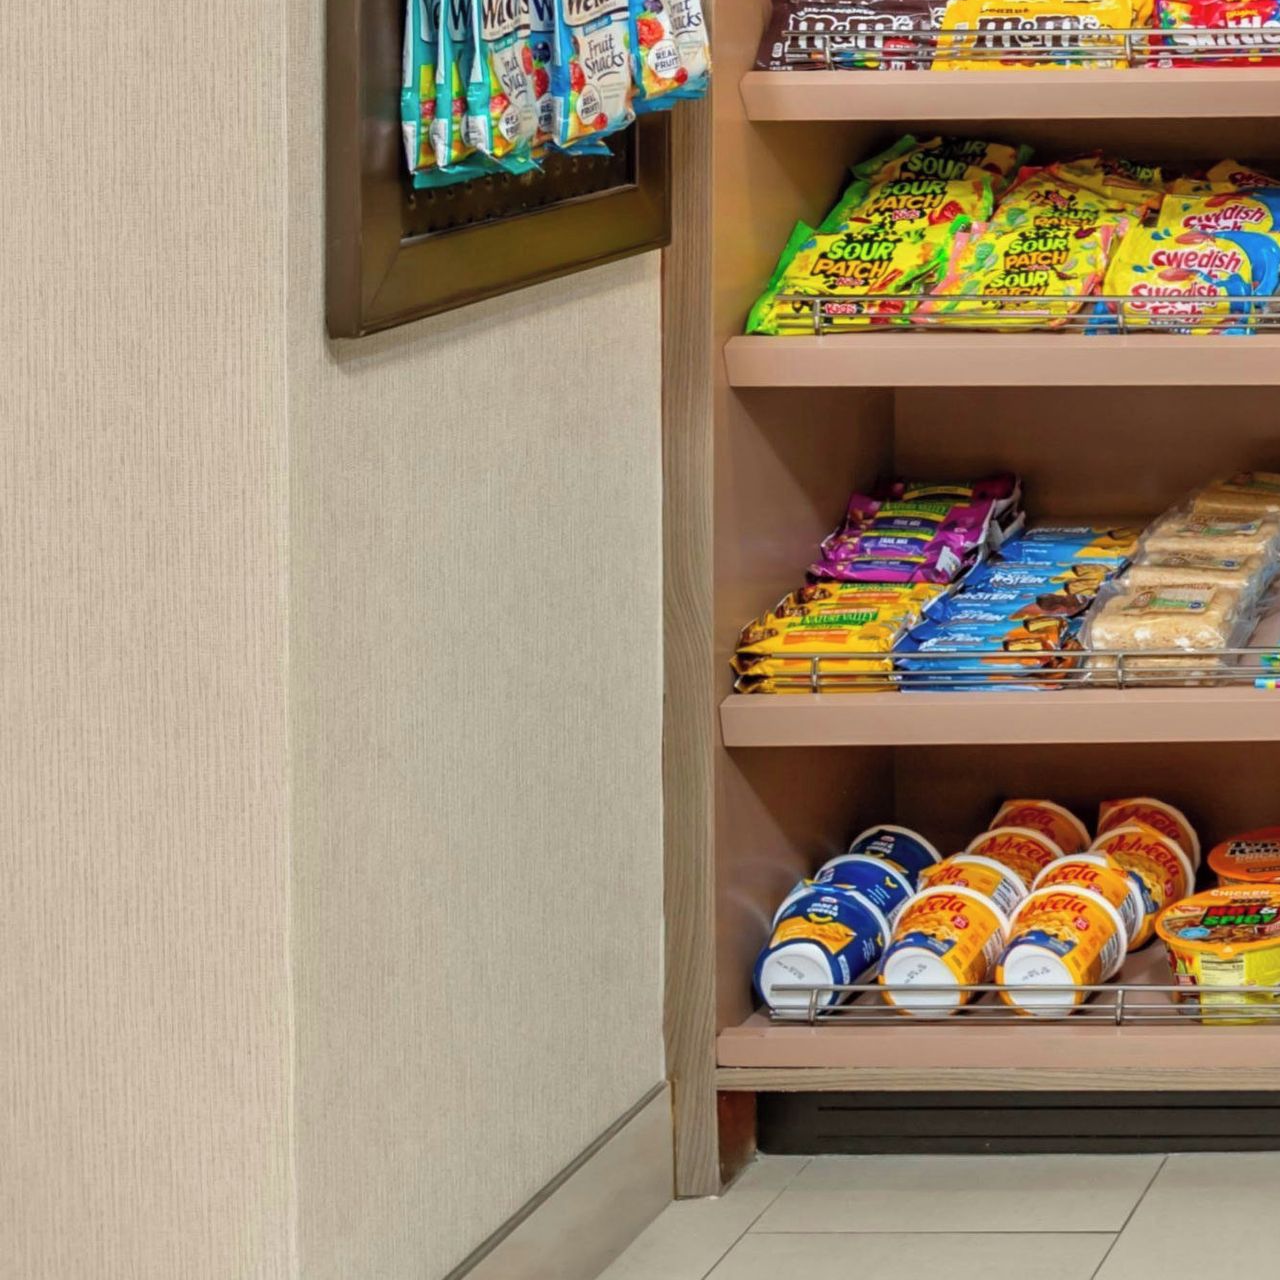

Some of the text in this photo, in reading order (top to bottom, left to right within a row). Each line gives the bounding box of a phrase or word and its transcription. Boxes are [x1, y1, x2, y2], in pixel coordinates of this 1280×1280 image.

[587, 34, 614, 59] Fruit
[584, 52, 624, 79] Snacks
[826, 239, 896, 260] SOUR
[1008, 237, 1070, 252] SOUR
[811, 260, 891, 280] PATCH
[1004, 251, 1071, 269] PATCH
[1151, 249, 1242, 272] Swedish
